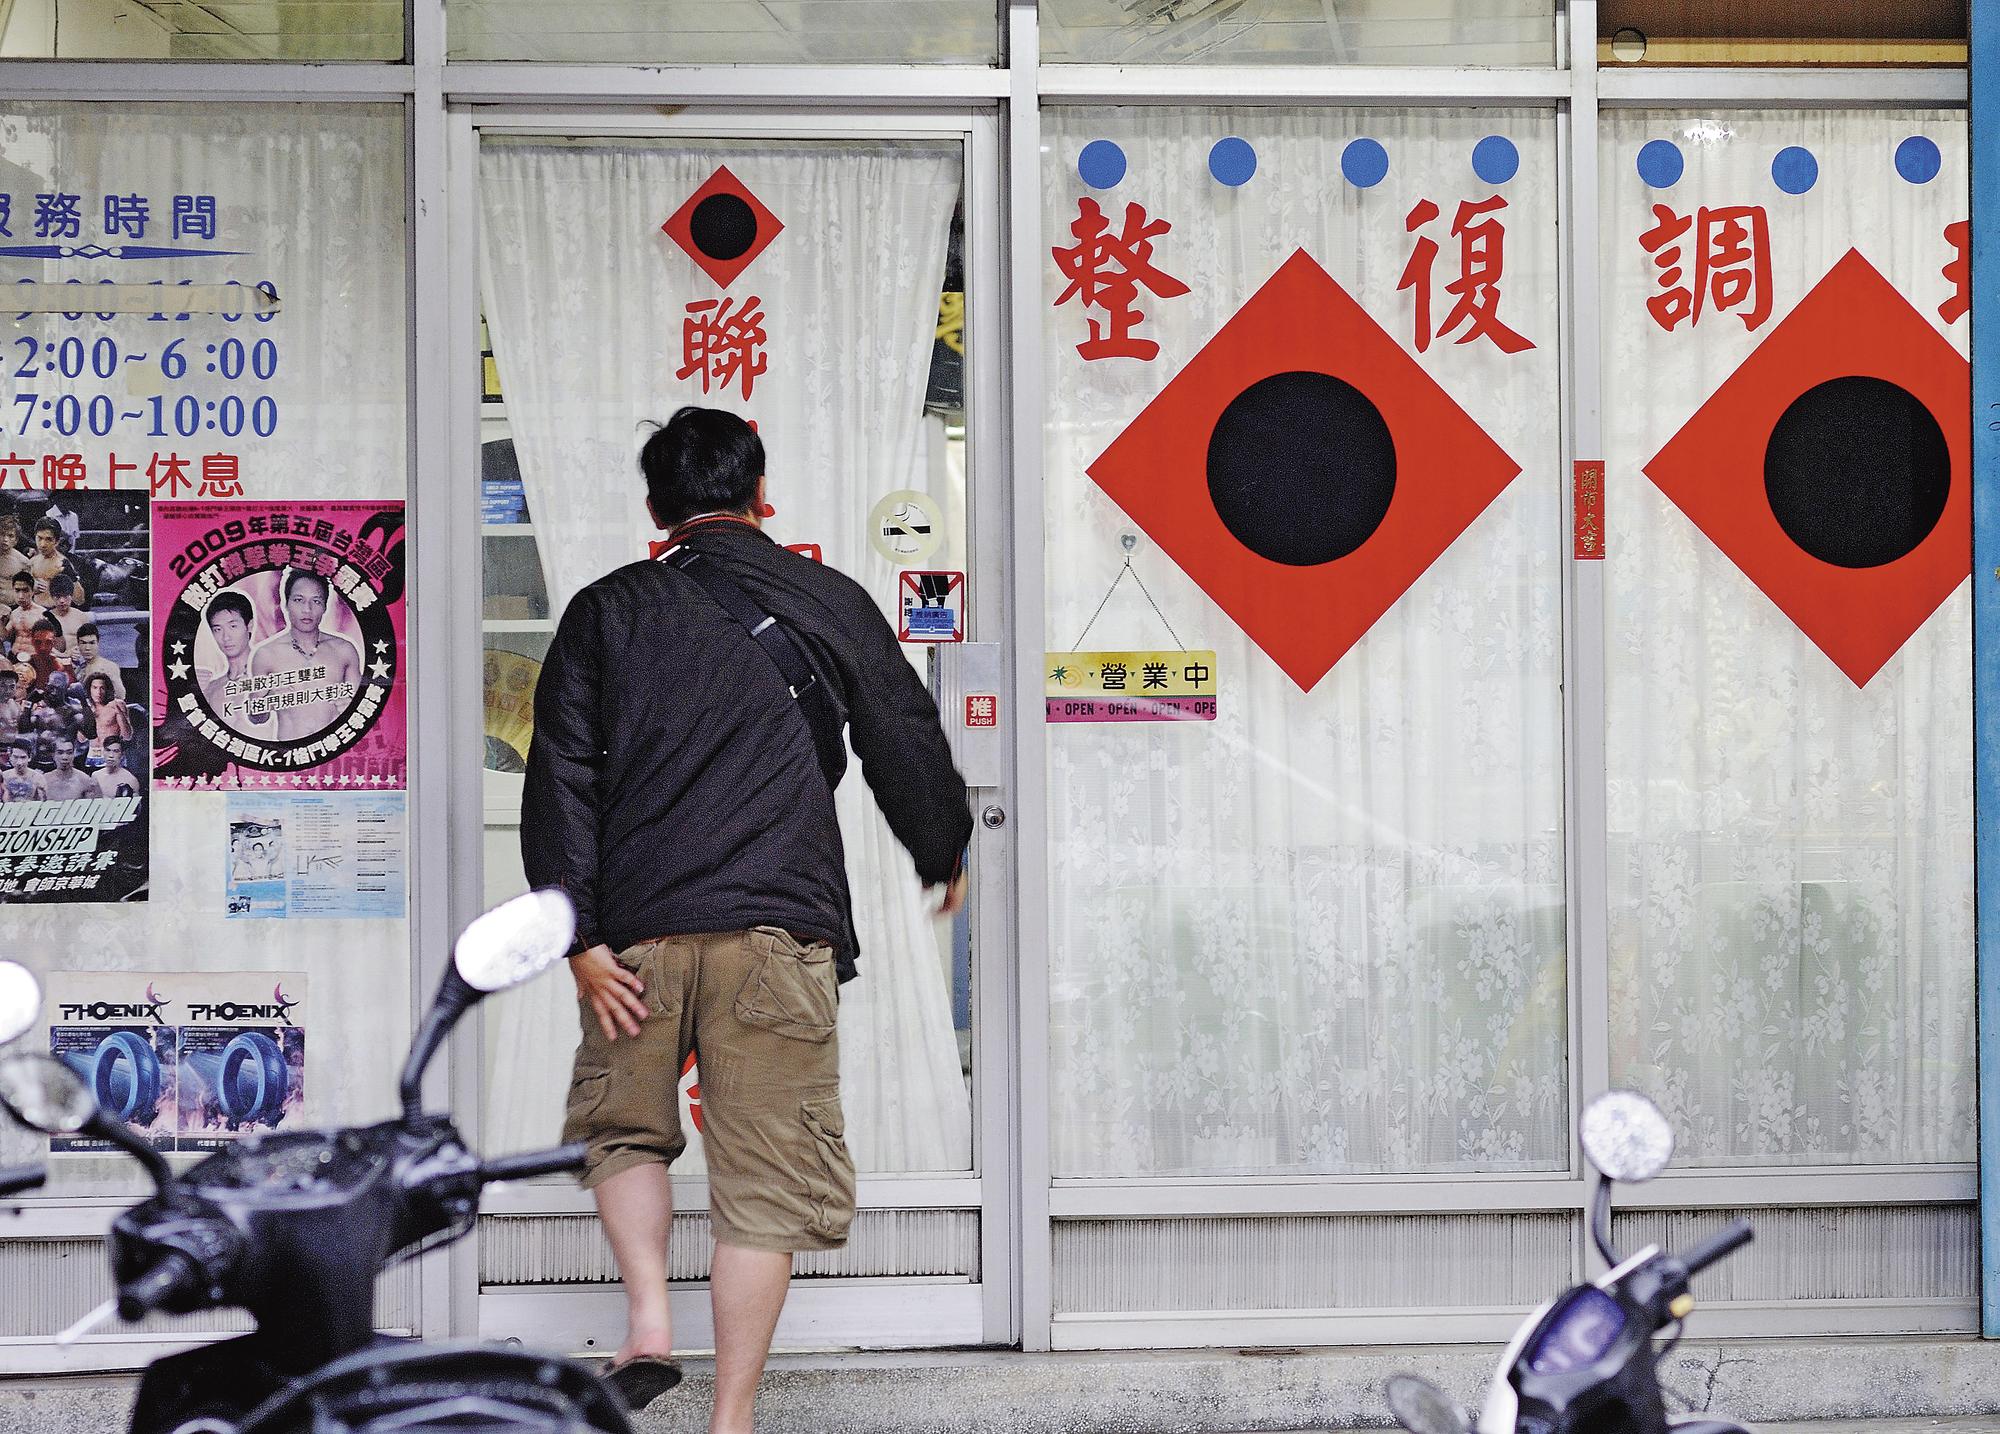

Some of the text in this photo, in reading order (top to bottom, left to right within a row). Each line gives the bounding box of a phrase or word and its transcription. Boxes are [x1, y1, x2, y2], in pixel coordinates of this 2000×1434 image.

[676, 295, 767, 401] 聯
[0, 452, 243, 497] 六晚上休息
[225, 666, 326, 696] 台灣散打王雙雄
[1100, 662, 1209, 690] 營業中
[971, 698, 992, 717] 推
[1065, 703, 1094, 715] OPEN
[1108, 702, 1137, 715] OPEN
[1152, 702, 1181, 715] OPEN
[59, 1001, 165, 1025] PHOENIX
[187, 1001, 293, 1025] PHOENIX
